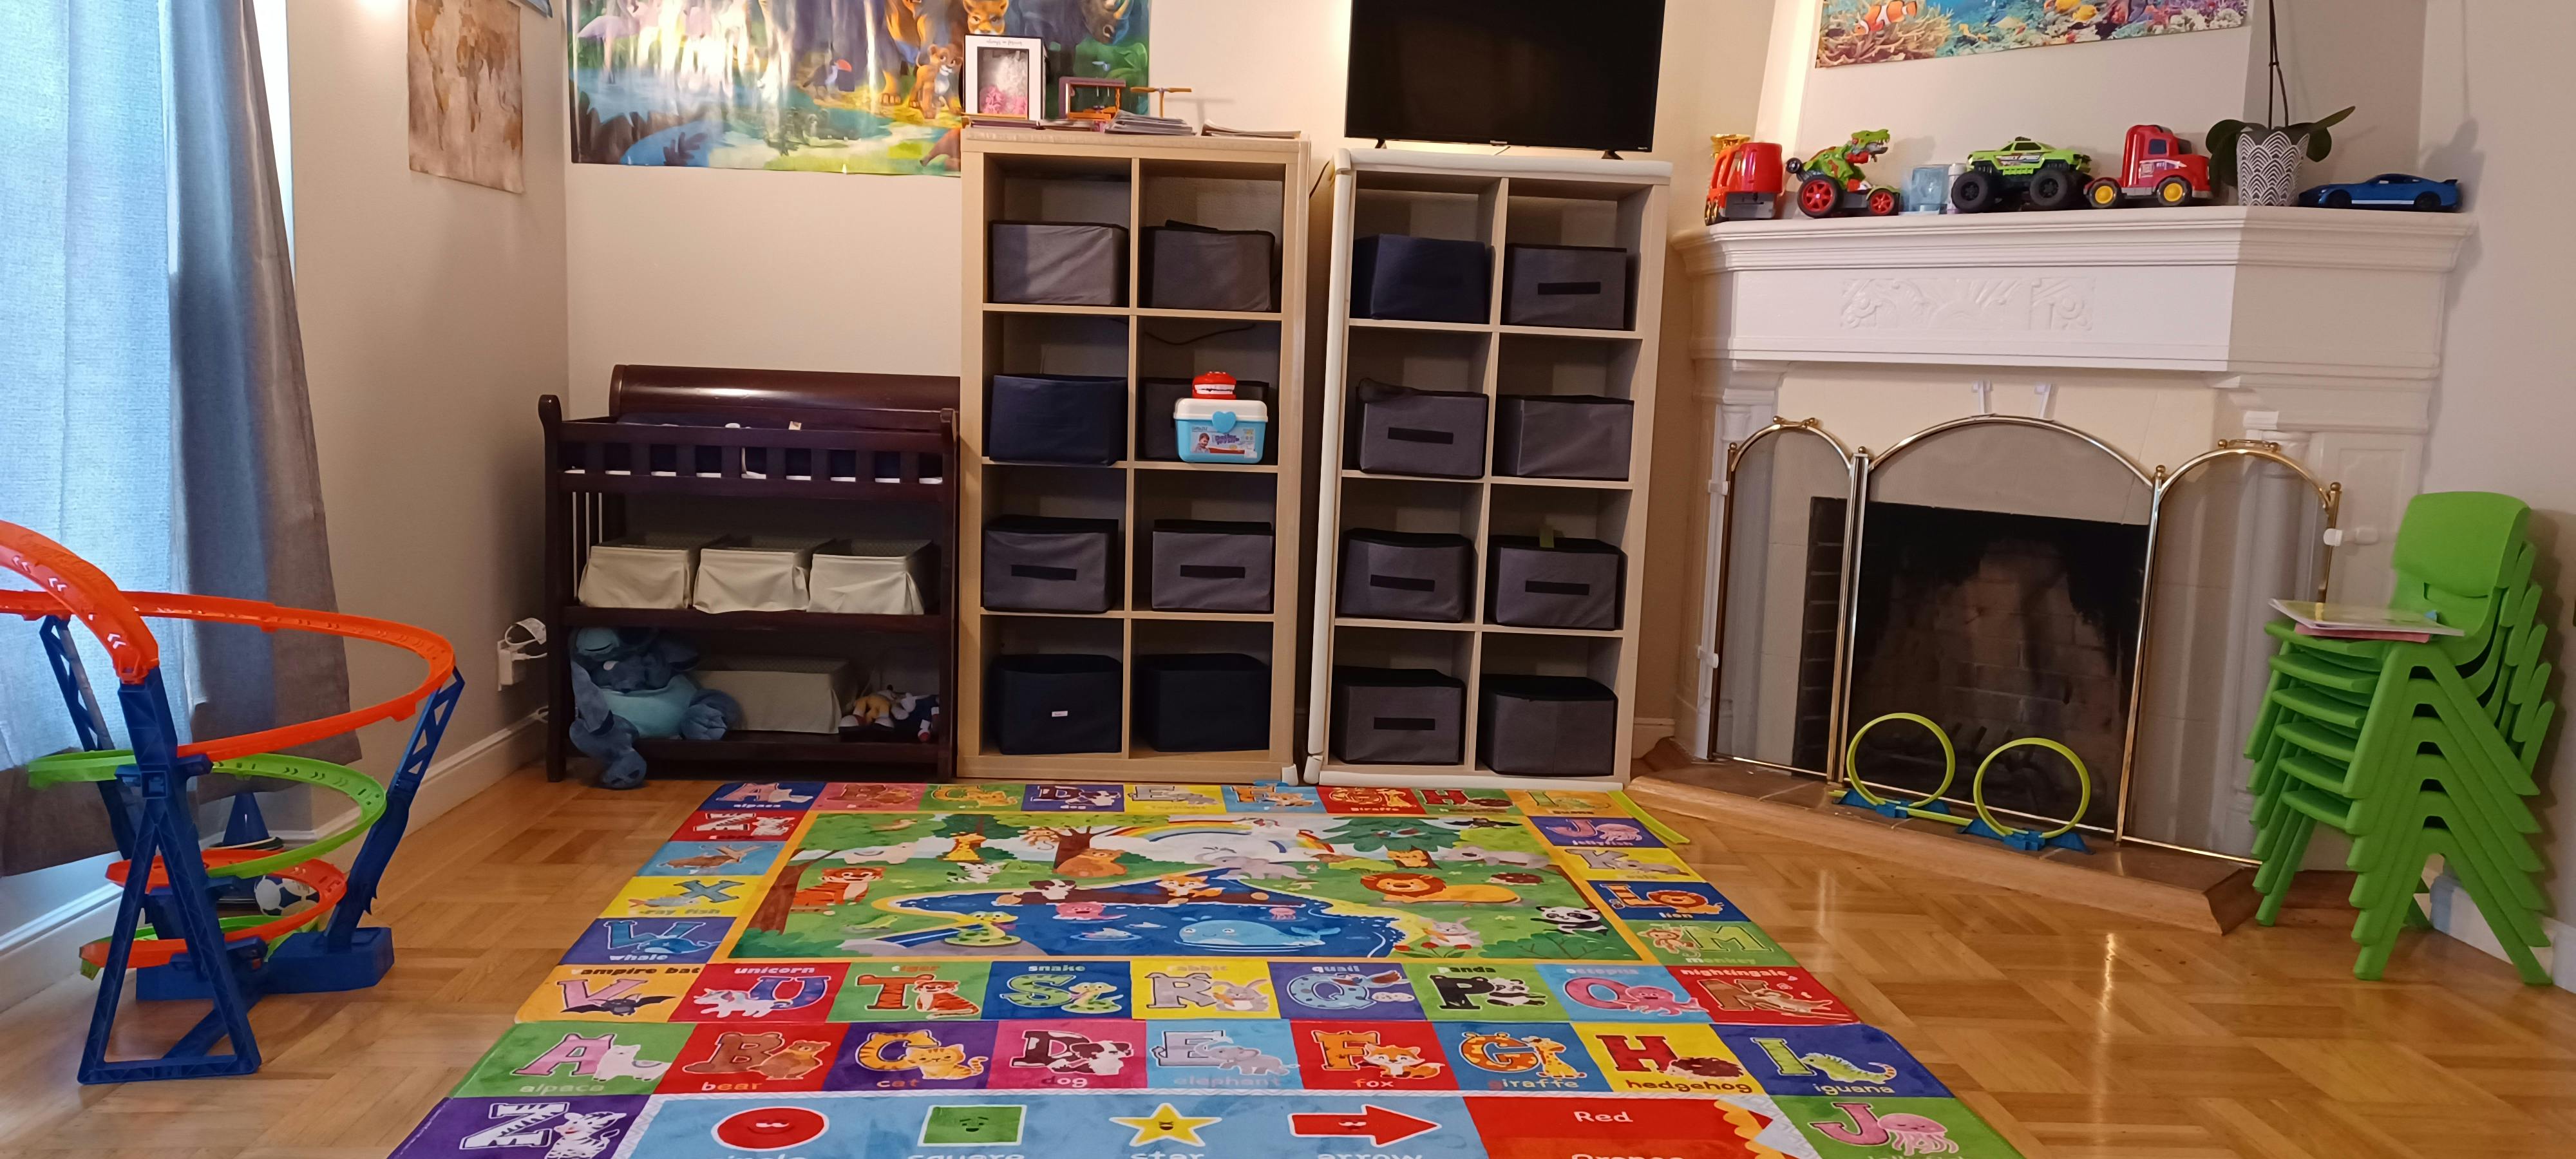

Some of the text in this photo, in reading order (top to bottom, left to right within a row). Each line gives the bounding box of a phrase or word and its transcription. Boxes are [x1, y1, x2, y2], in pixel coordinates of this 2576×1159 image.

[571, 966, 701, 976] vampire bat
[734, 965, 815, 975] unicorn
[1680, 968, 1790, 978] nightingale
[1595, 1034, 1679, 1073] H
[701, 1082, 762, 1092] bear
[876, 1079, 919, 1088] cat
[1041, 1076, 1088, 1088] dog
[1174, 1075, 1280, 1088] elephant
[1353, 1078, 1394, 1088] fox
[1488, 1078, 1580, 1091] giraffe
[1625, 1080, 1754, 1093] hedgehog
[519, 1083, 605, 1094] alpaca
[1813, 1082, 1895, 1097] iguana
[1573, 1111, 1634, 1124] Red
